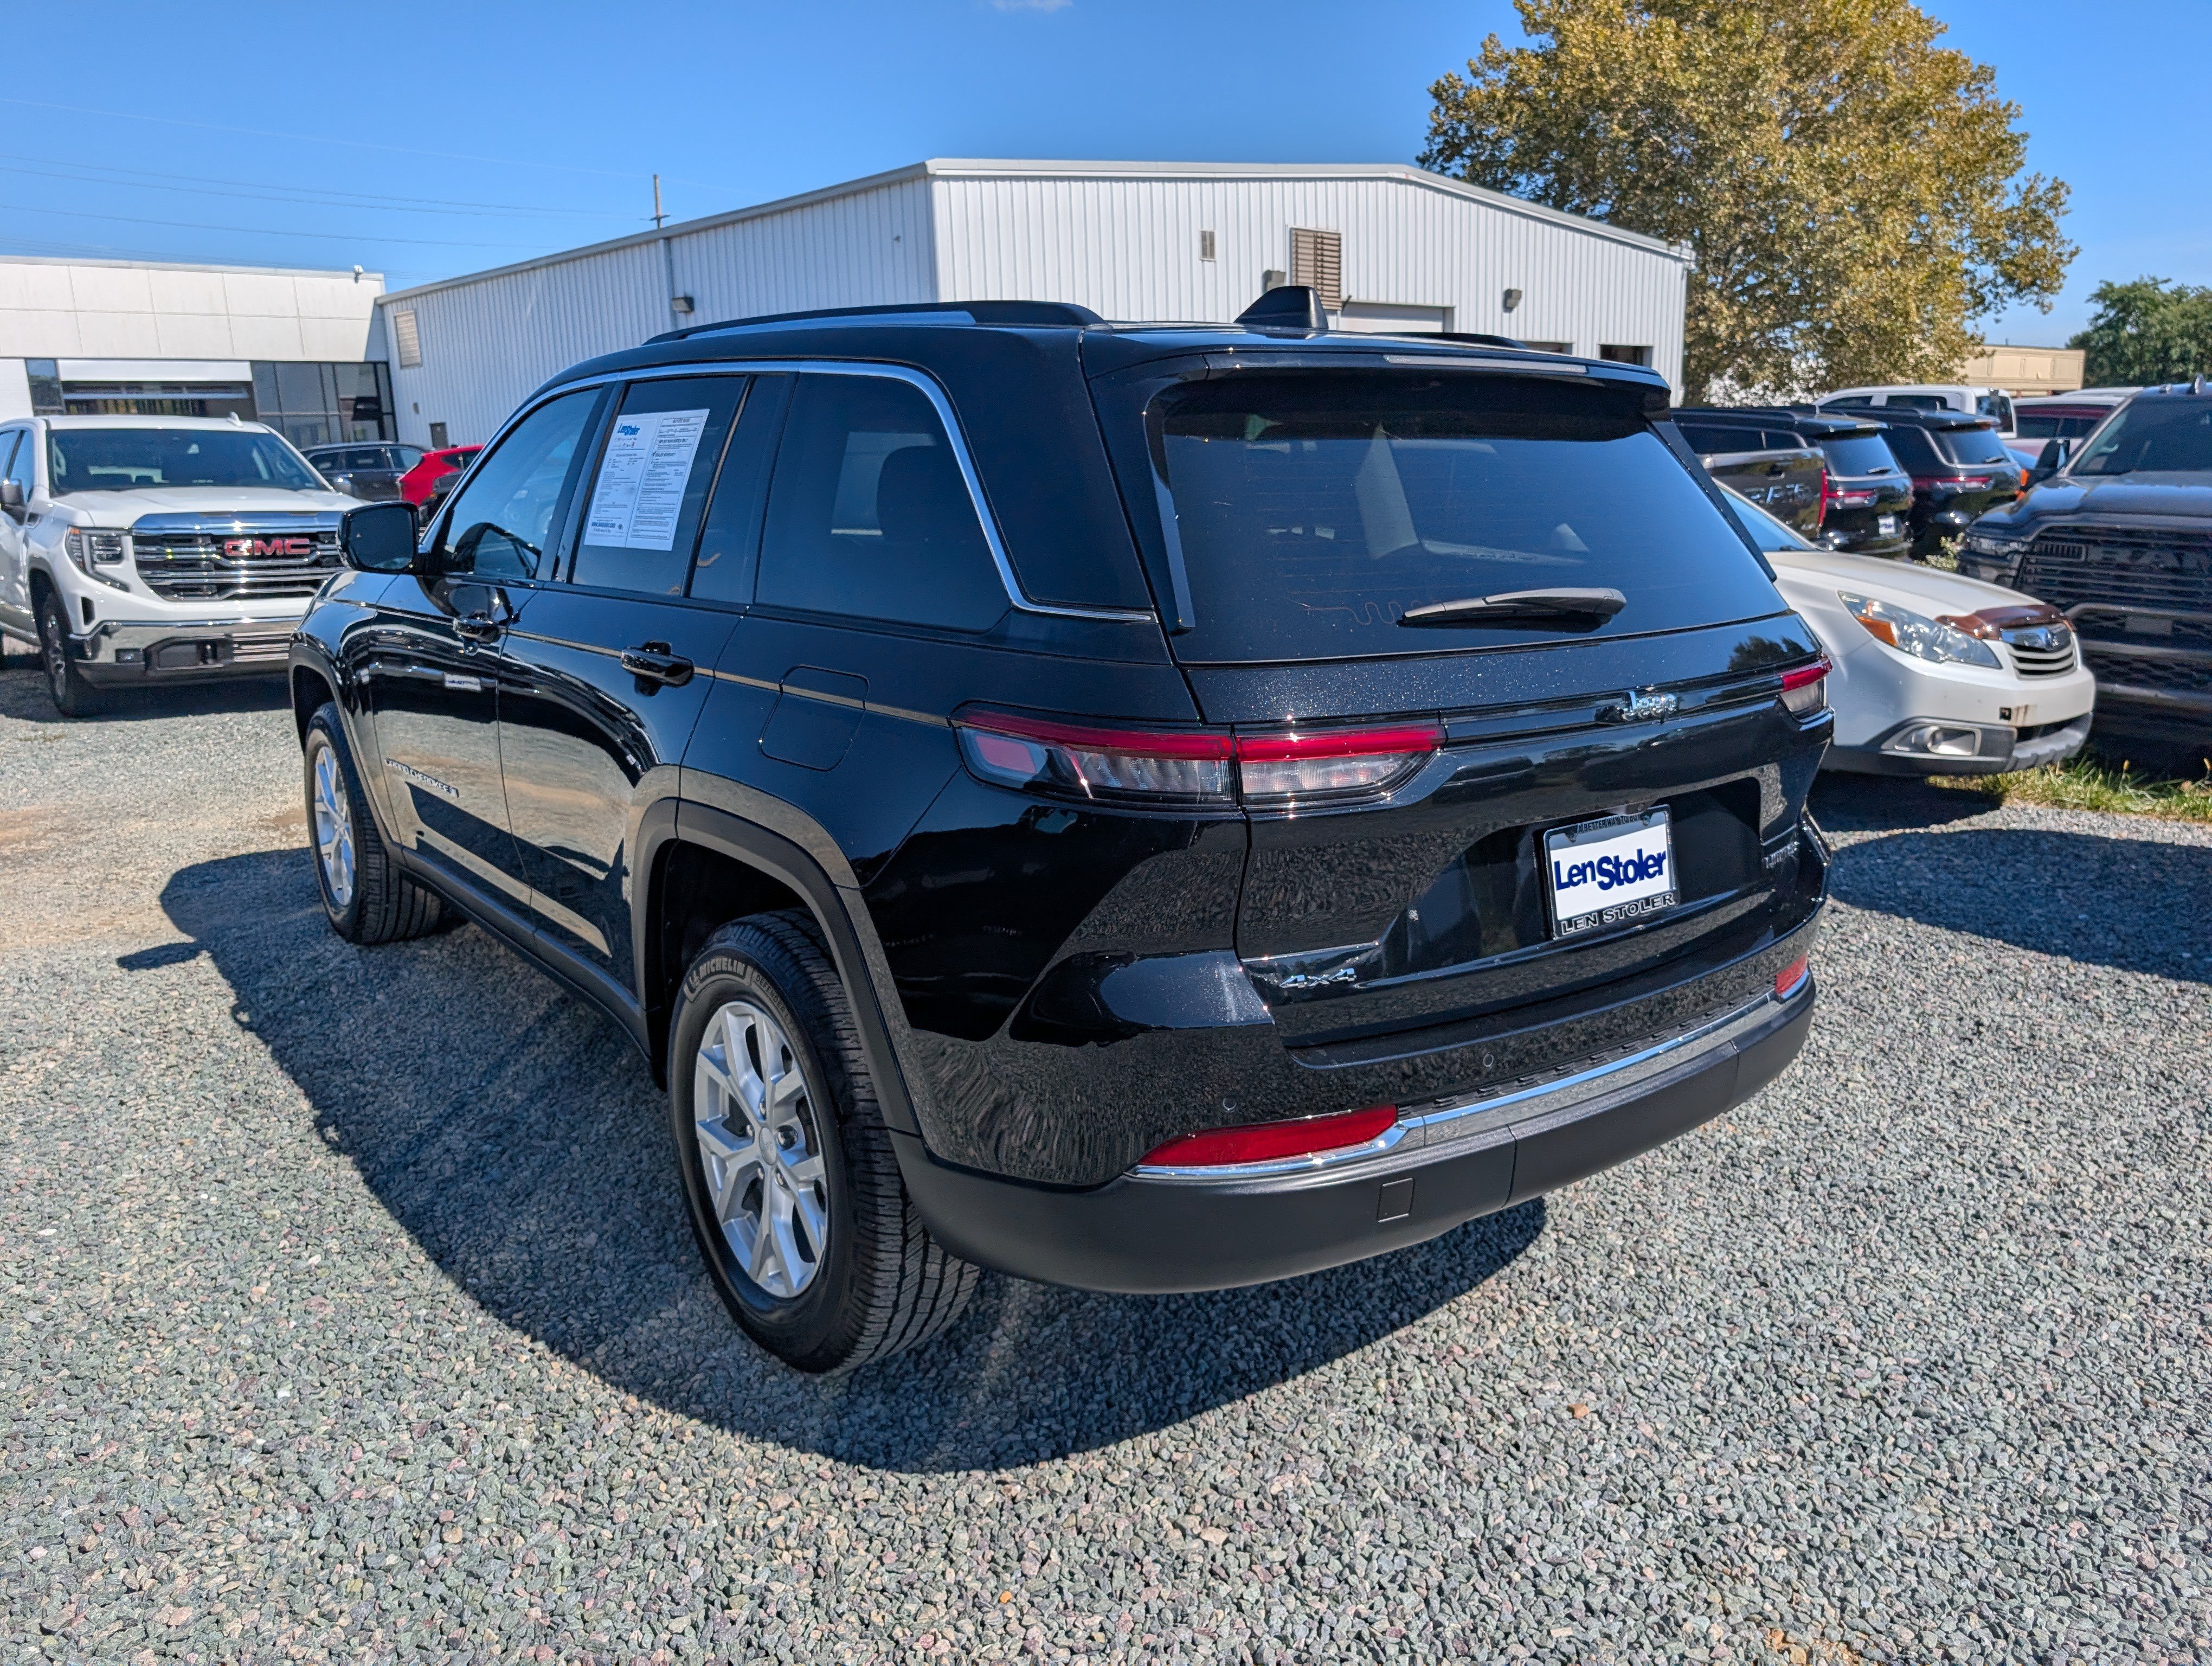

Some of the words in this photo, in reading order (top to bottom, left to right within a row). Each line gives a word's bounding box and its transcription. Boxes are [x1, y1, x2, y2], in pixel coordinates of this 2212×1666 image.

[224, 538, 311, 556] GMC
[1620, 690, 1677, 721] Jeep
[1584, 819, 1607, 832] BETTER
[1607, 816, 1620, 826] WAY
[1560, 912, 1599, 935] LEN
[1603, 892, 1676, 923] STOLER
[699, 958, 745, 979] MICHELIN
[755, 975, 786, 1014] DEFENDER
